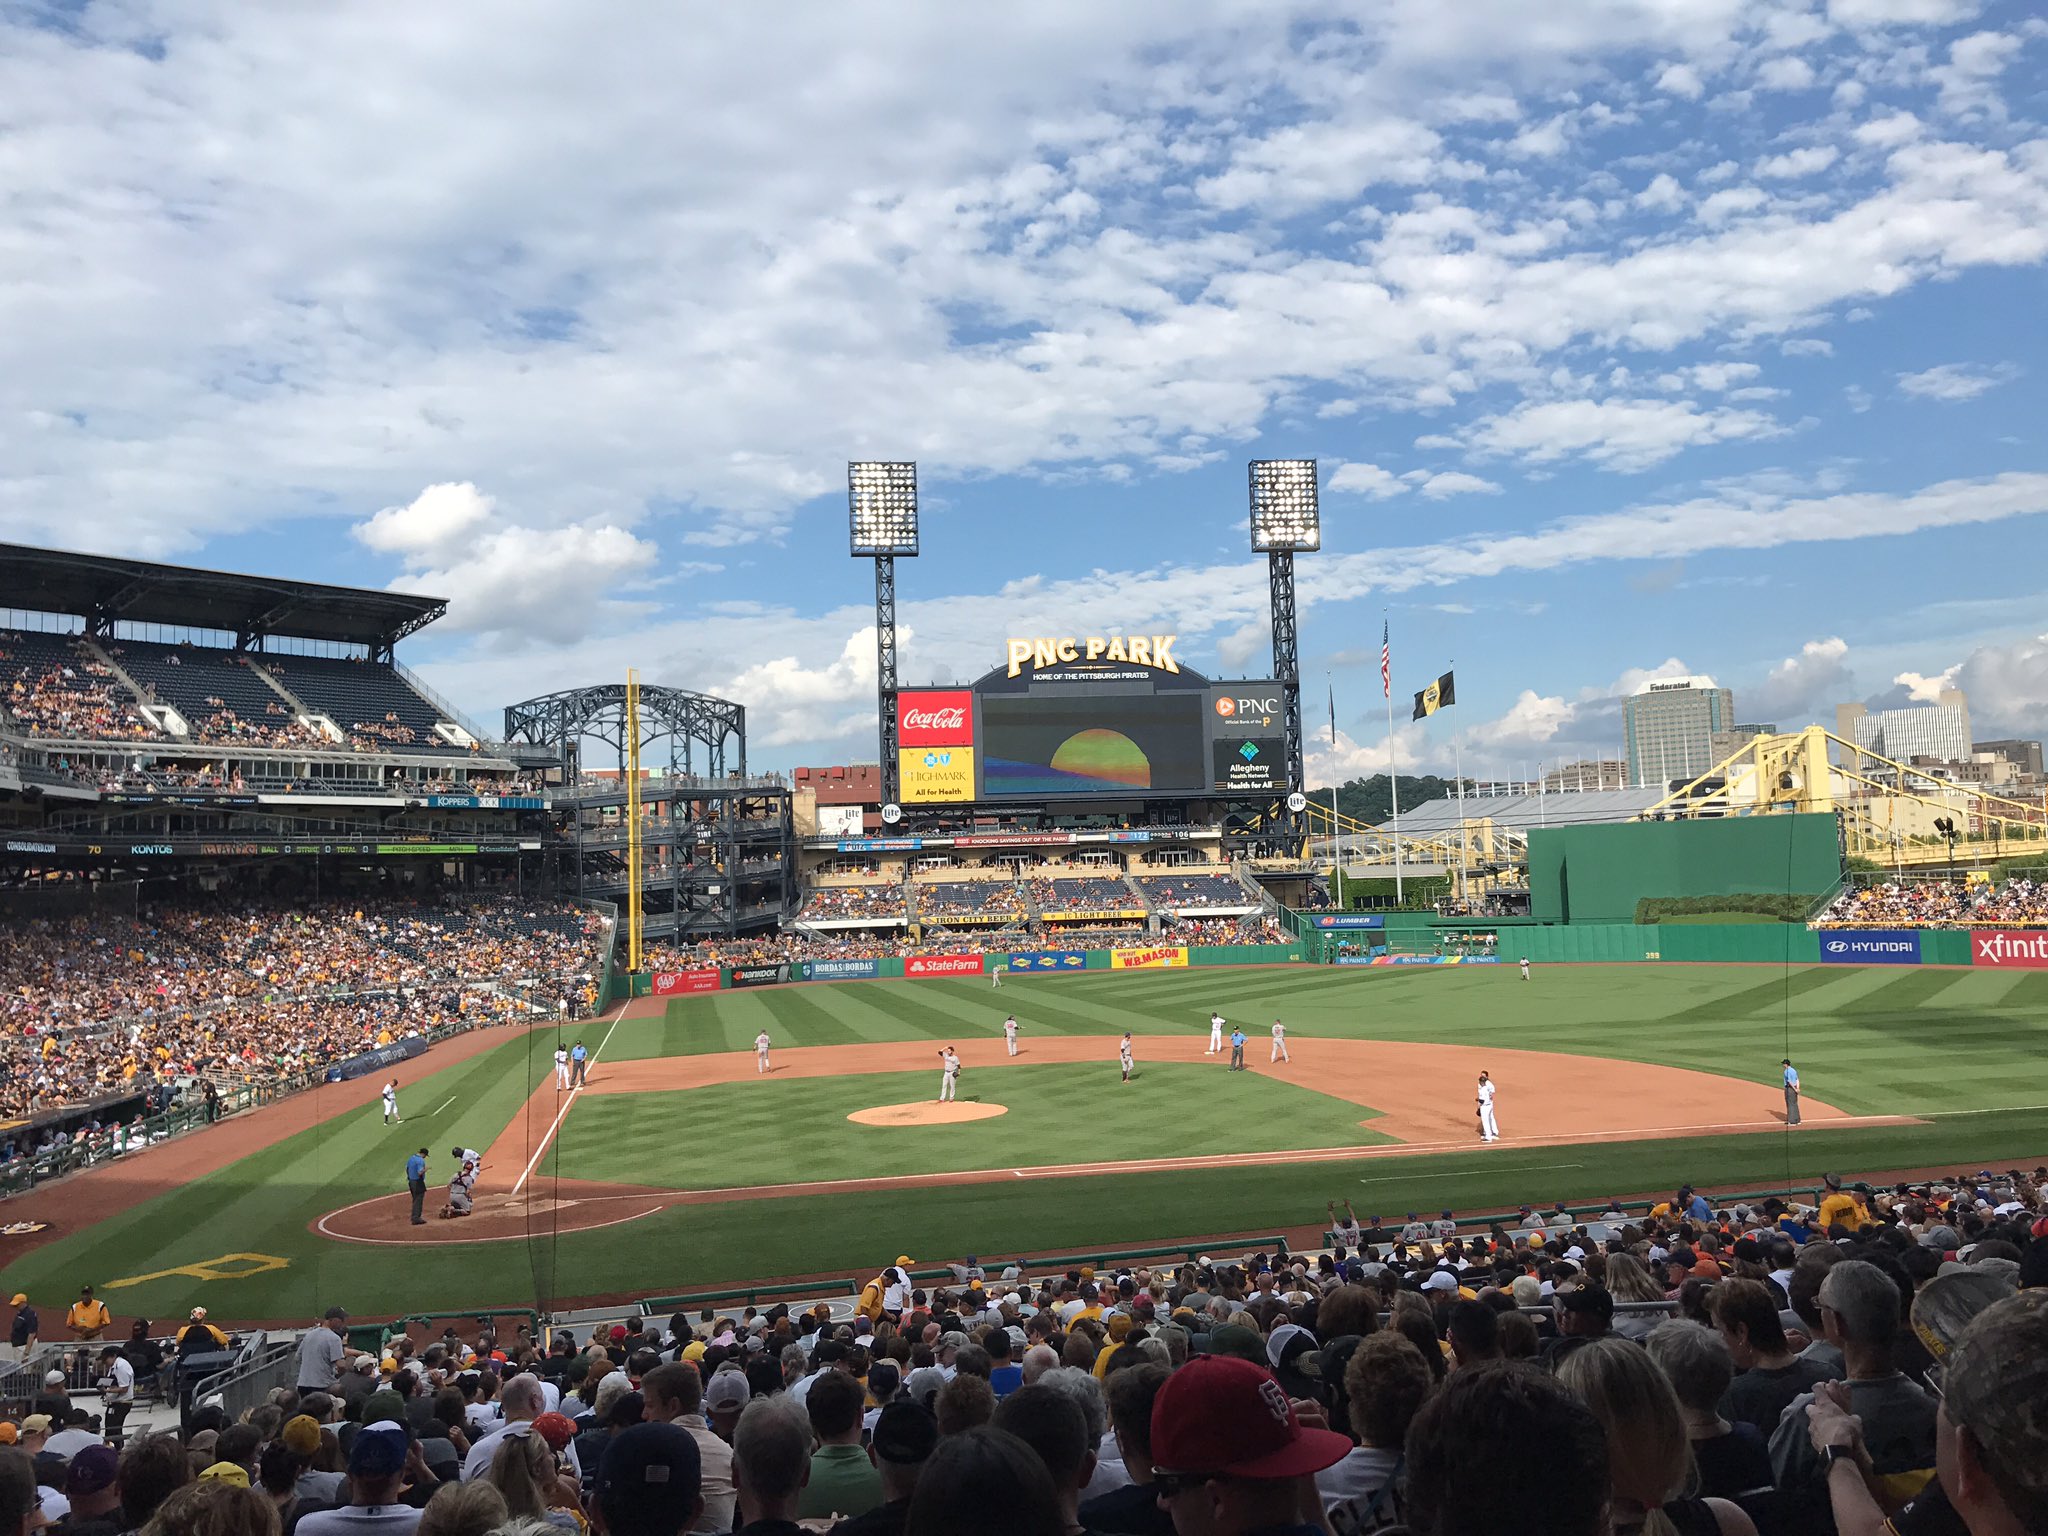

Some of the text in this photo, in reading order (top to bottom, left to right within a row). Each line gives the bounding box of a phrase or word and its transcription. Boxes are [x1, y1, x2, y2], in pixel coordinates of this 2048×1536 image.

[1006, 635, 1180, 679] PNC PARK
[1033, 673, 1053, 681] HOME
[1064, 672, 1078, 680] THE
[1078, 672, 1121, 680] PITTSBURGH
[1121, 671, 1149, 679] PIRATES
[1650, 681, 1690, 691] Federated
[1237, 698, 1278, 714] PNC
[903, 707, 966, 729] Coca-Cola
[1230, 764, 1270, 773] Allegheny
[910, 771, 966, 781] HIGHMARK
[1227, 781, 1273, 789] Health for All
[927, 788, 937, 796] for
[437, 796, 470, 806] KOPPERS
[1289, 797, 1304, 807] Lite
[845, 809, 860, 820] Lite
[884, 808, 899, 818] Lite
[7, 841, 56, 853] CONSOLIDATED.COM
[88, 845, 101, 854] 70
[131, 845, 173, 854] KONTOS
[1073, 911, 1100, 919] LIGHT
[1852, 942, 1913, 952] HYUNDAI
[1978, 934, 2048, 963] xfinit
[815, 962, 842, 972] BORDAS
[845, 961, 873, 971] BORDAS
[658, 976, 674, 987] AAA
[1573, 1283, 1586, 1292] P
